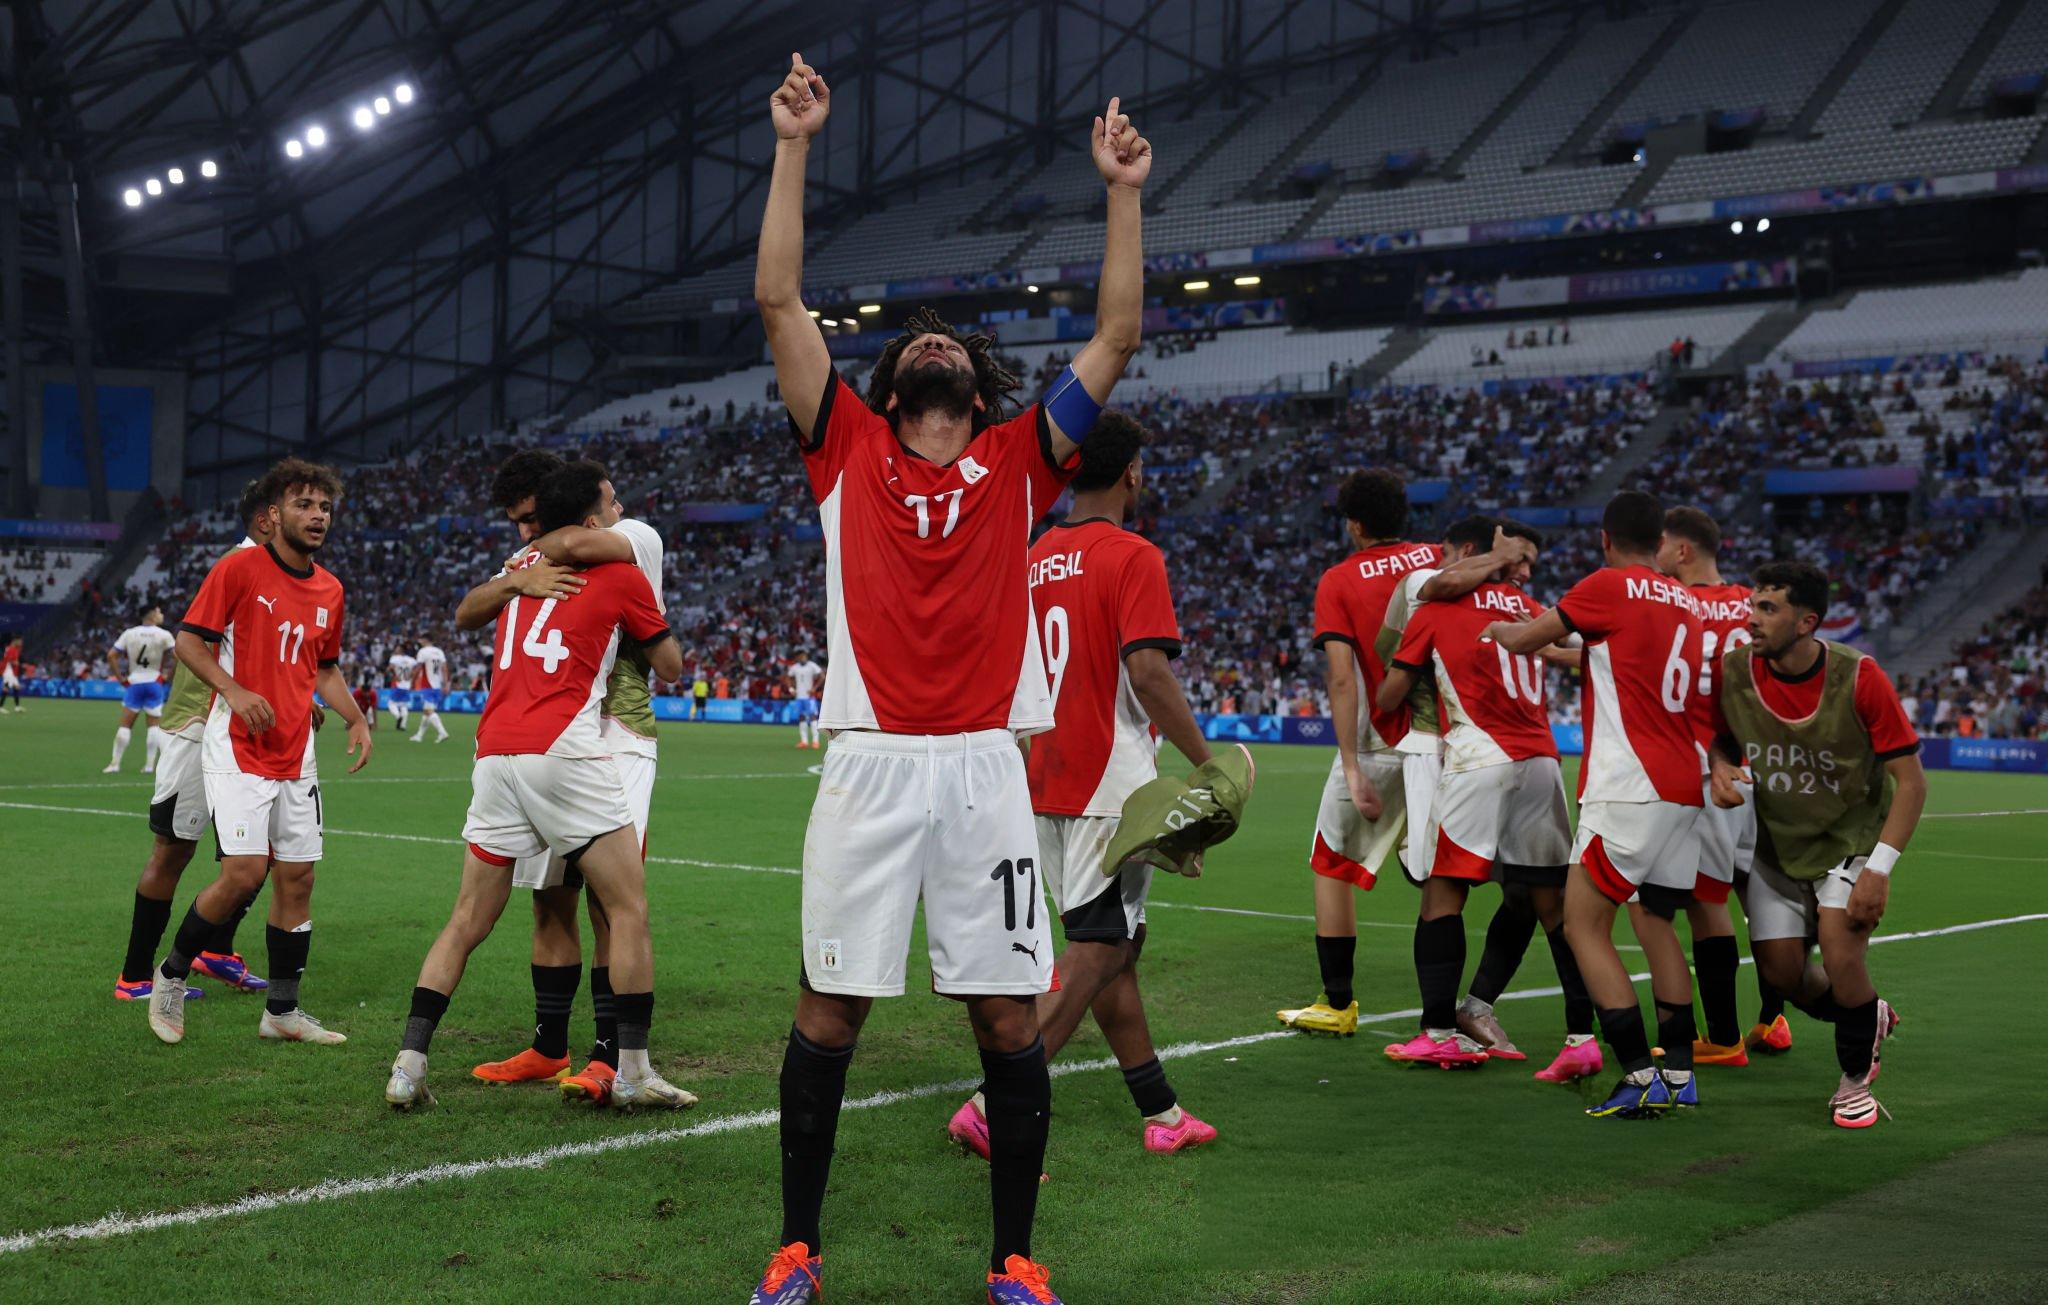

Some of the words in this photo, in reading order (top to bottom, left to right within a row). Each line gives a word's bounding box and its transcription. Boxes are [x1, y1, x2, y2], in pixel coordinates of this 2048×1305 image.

[904, 488, 964, 539] 17
[1359, 546, 1435, 579] O.FAYED
[136, 643, 150, 668] 4
[277, 620, 305, 665] 11
[500, 591, 570, 674] 14
[1044, 605, 1070, 717] 9
[1661, 623, 1691, 713] 6
[991, 858, 1036, 931] 17
